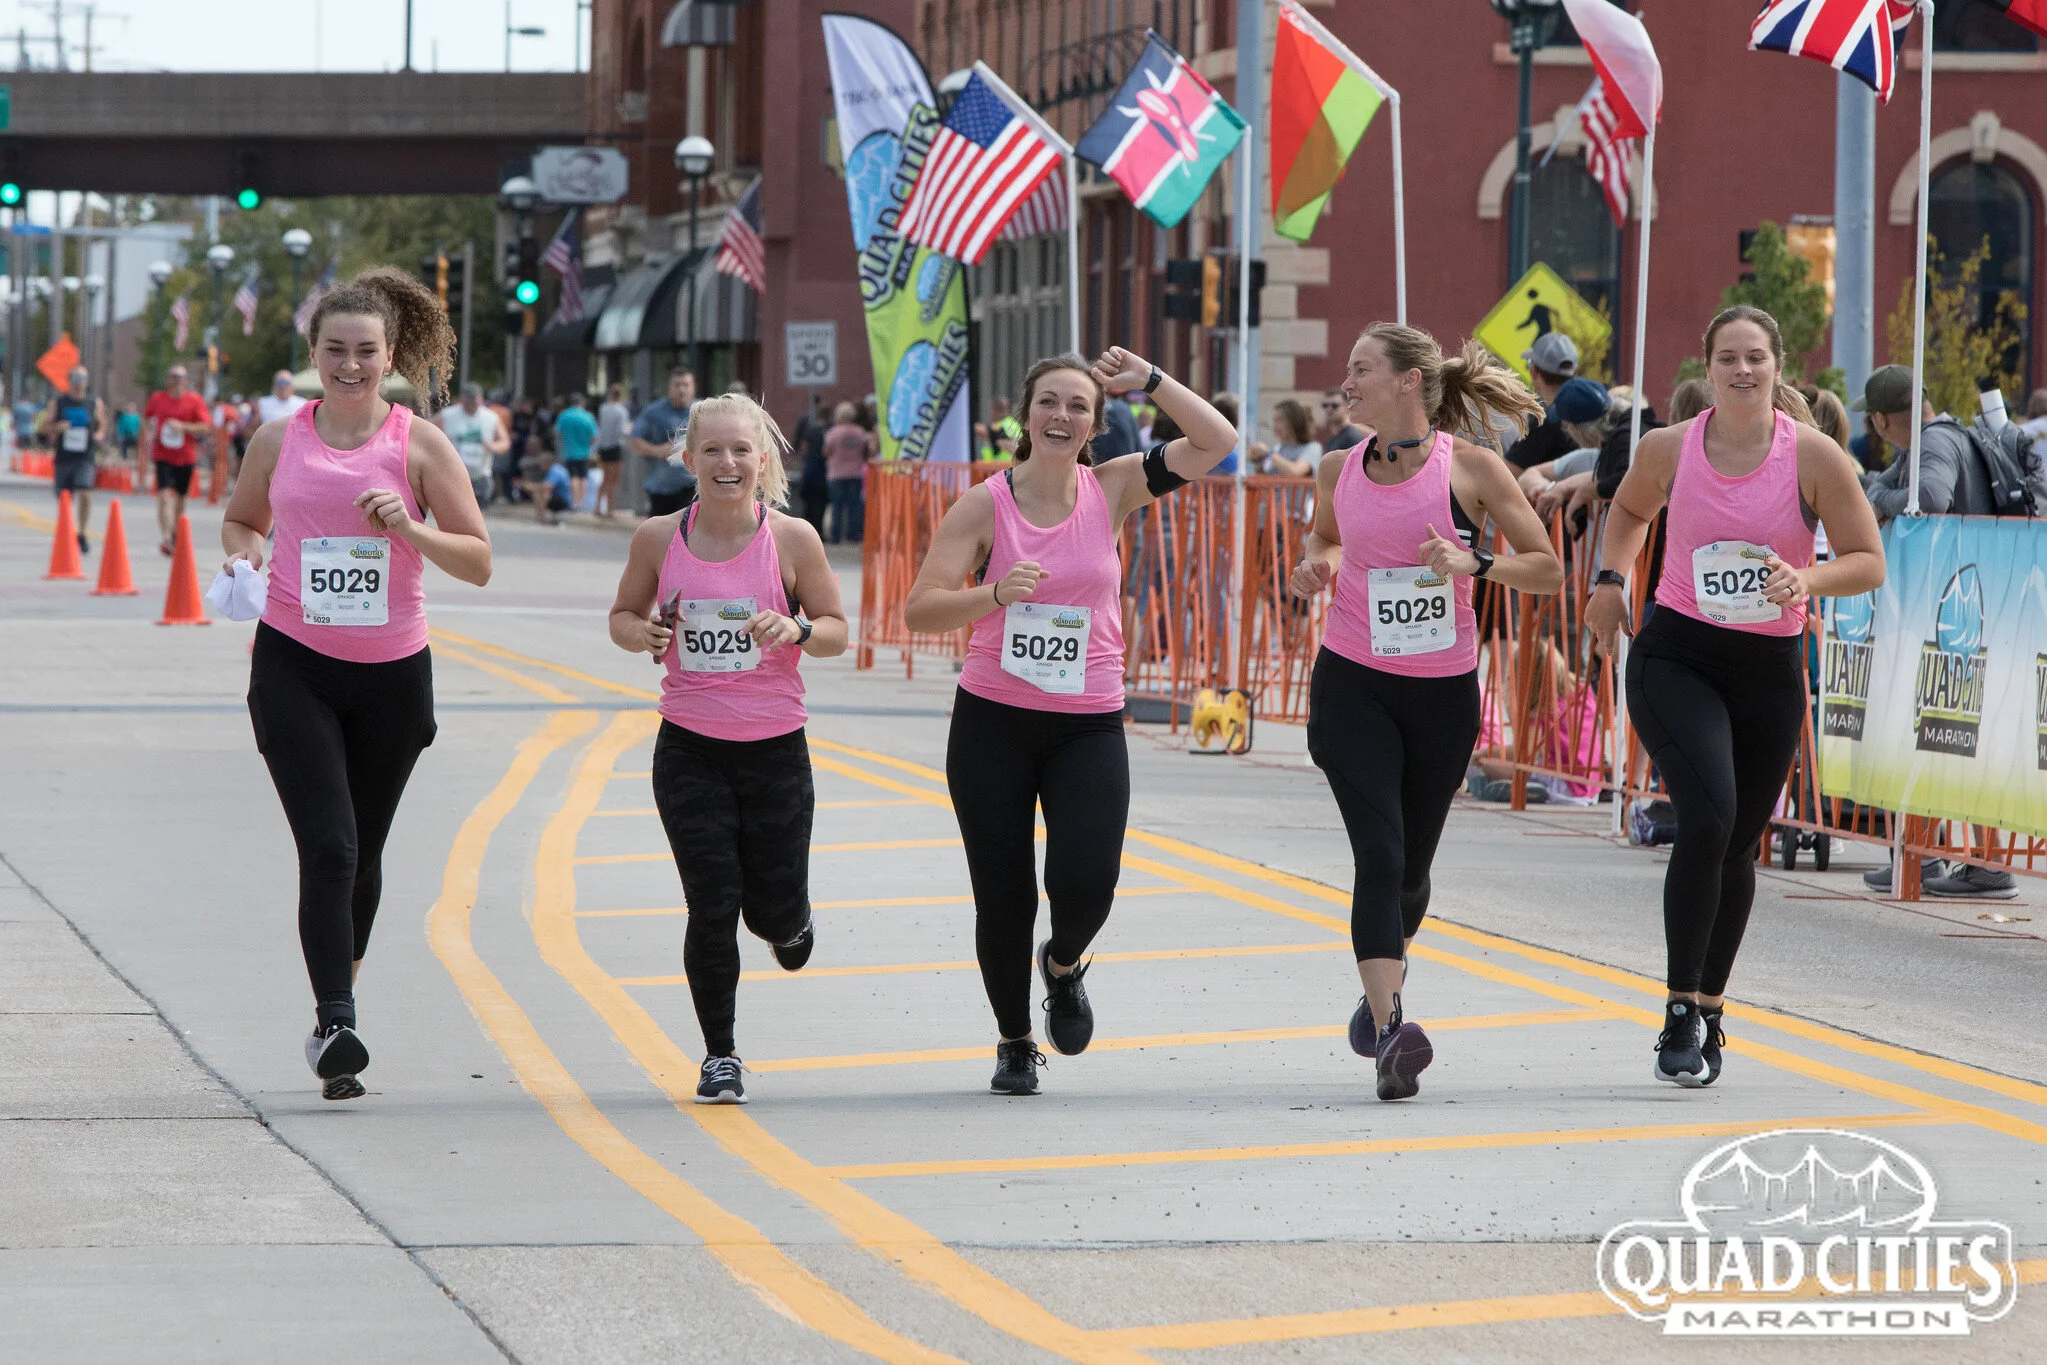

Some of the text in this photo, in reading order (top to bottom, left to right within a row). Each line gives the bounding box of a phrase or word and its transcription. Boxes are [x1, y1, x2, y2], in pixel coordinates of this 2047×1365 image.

[860, 206, 901, 302] QUAD
[793, 353, 830, 378] 30
[926, 322, 968, 400] CITIES
[311, 568, 380, 594] 5029
[1703, 566, 1773, 596] 5029
[1377, 595, 1446, 625] 5029
[684, 629, 751, 655] 5029
[1011, 633, 1079, 662] 5029
[1382, 647, 1401, 655] 5029
[1924, 726, 1977, 748] MARATHON
